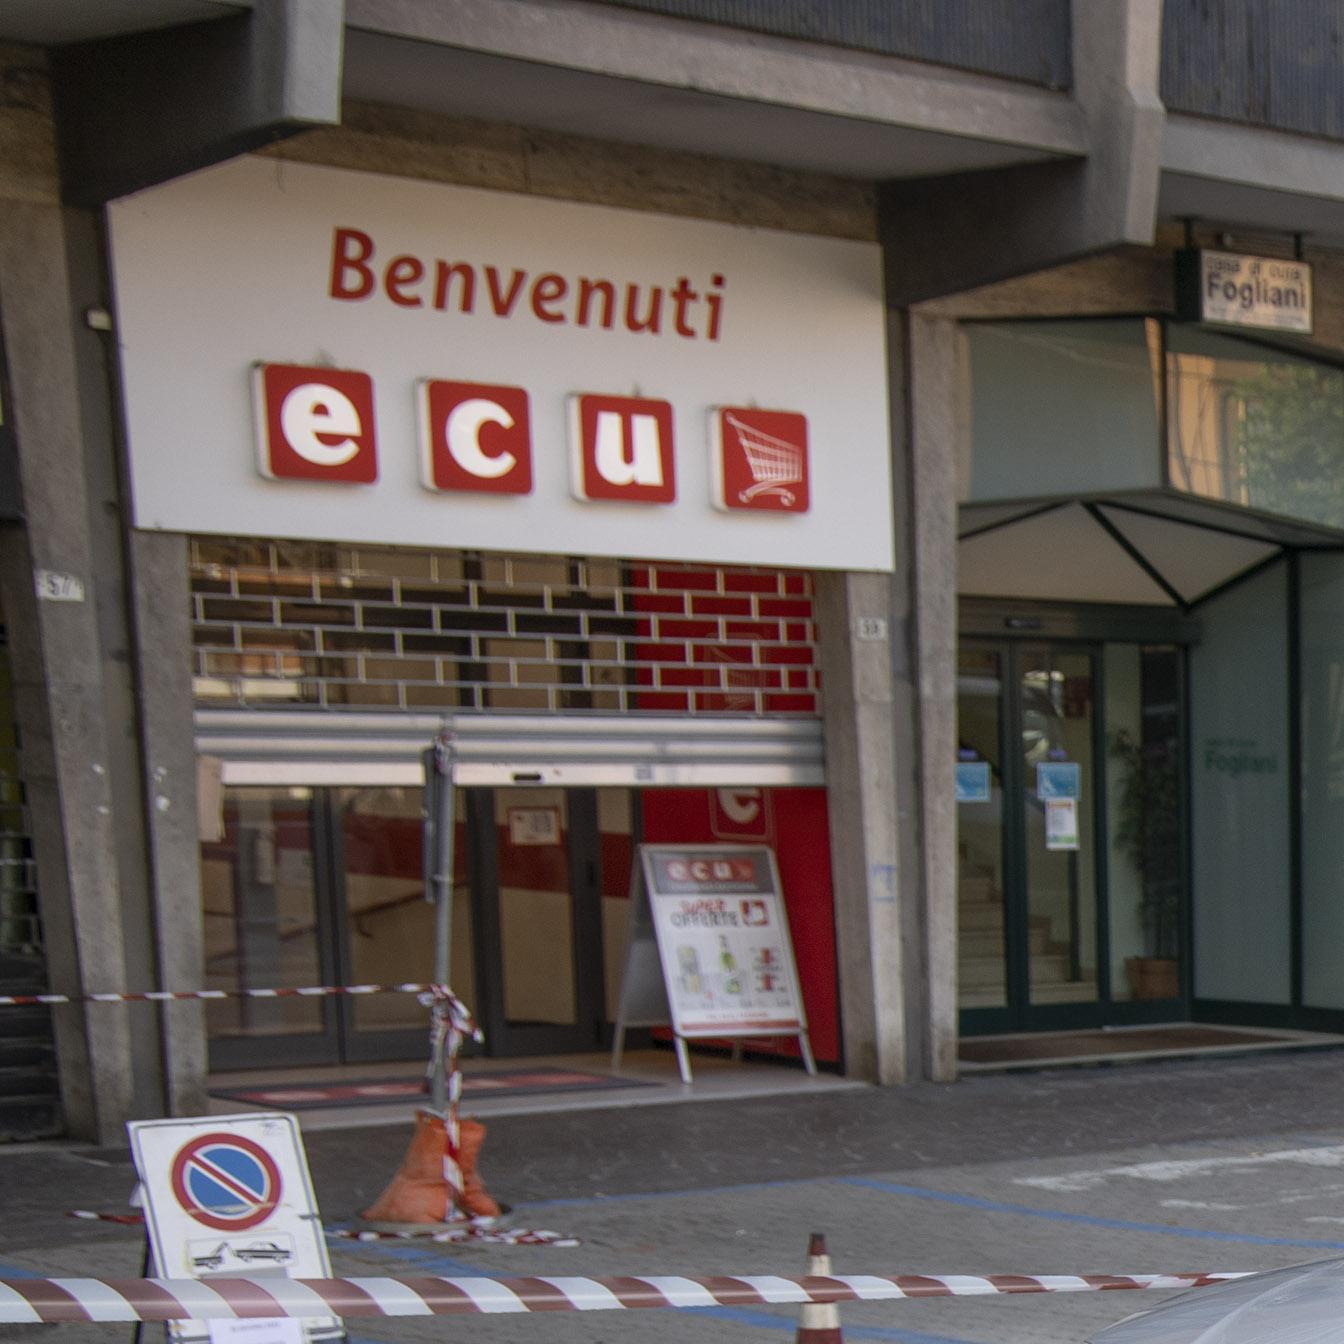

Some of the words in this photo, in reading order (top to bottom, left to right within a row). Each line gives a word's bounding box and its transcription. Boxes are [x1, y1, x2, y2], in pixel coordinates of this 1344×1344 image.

[329, 227, 726, 342] Benvenuti
[1207, 272, 1306, 310] Fogliani
[281, 383, 664, 487] ecu
[668, 861, 732, 881] ecu
